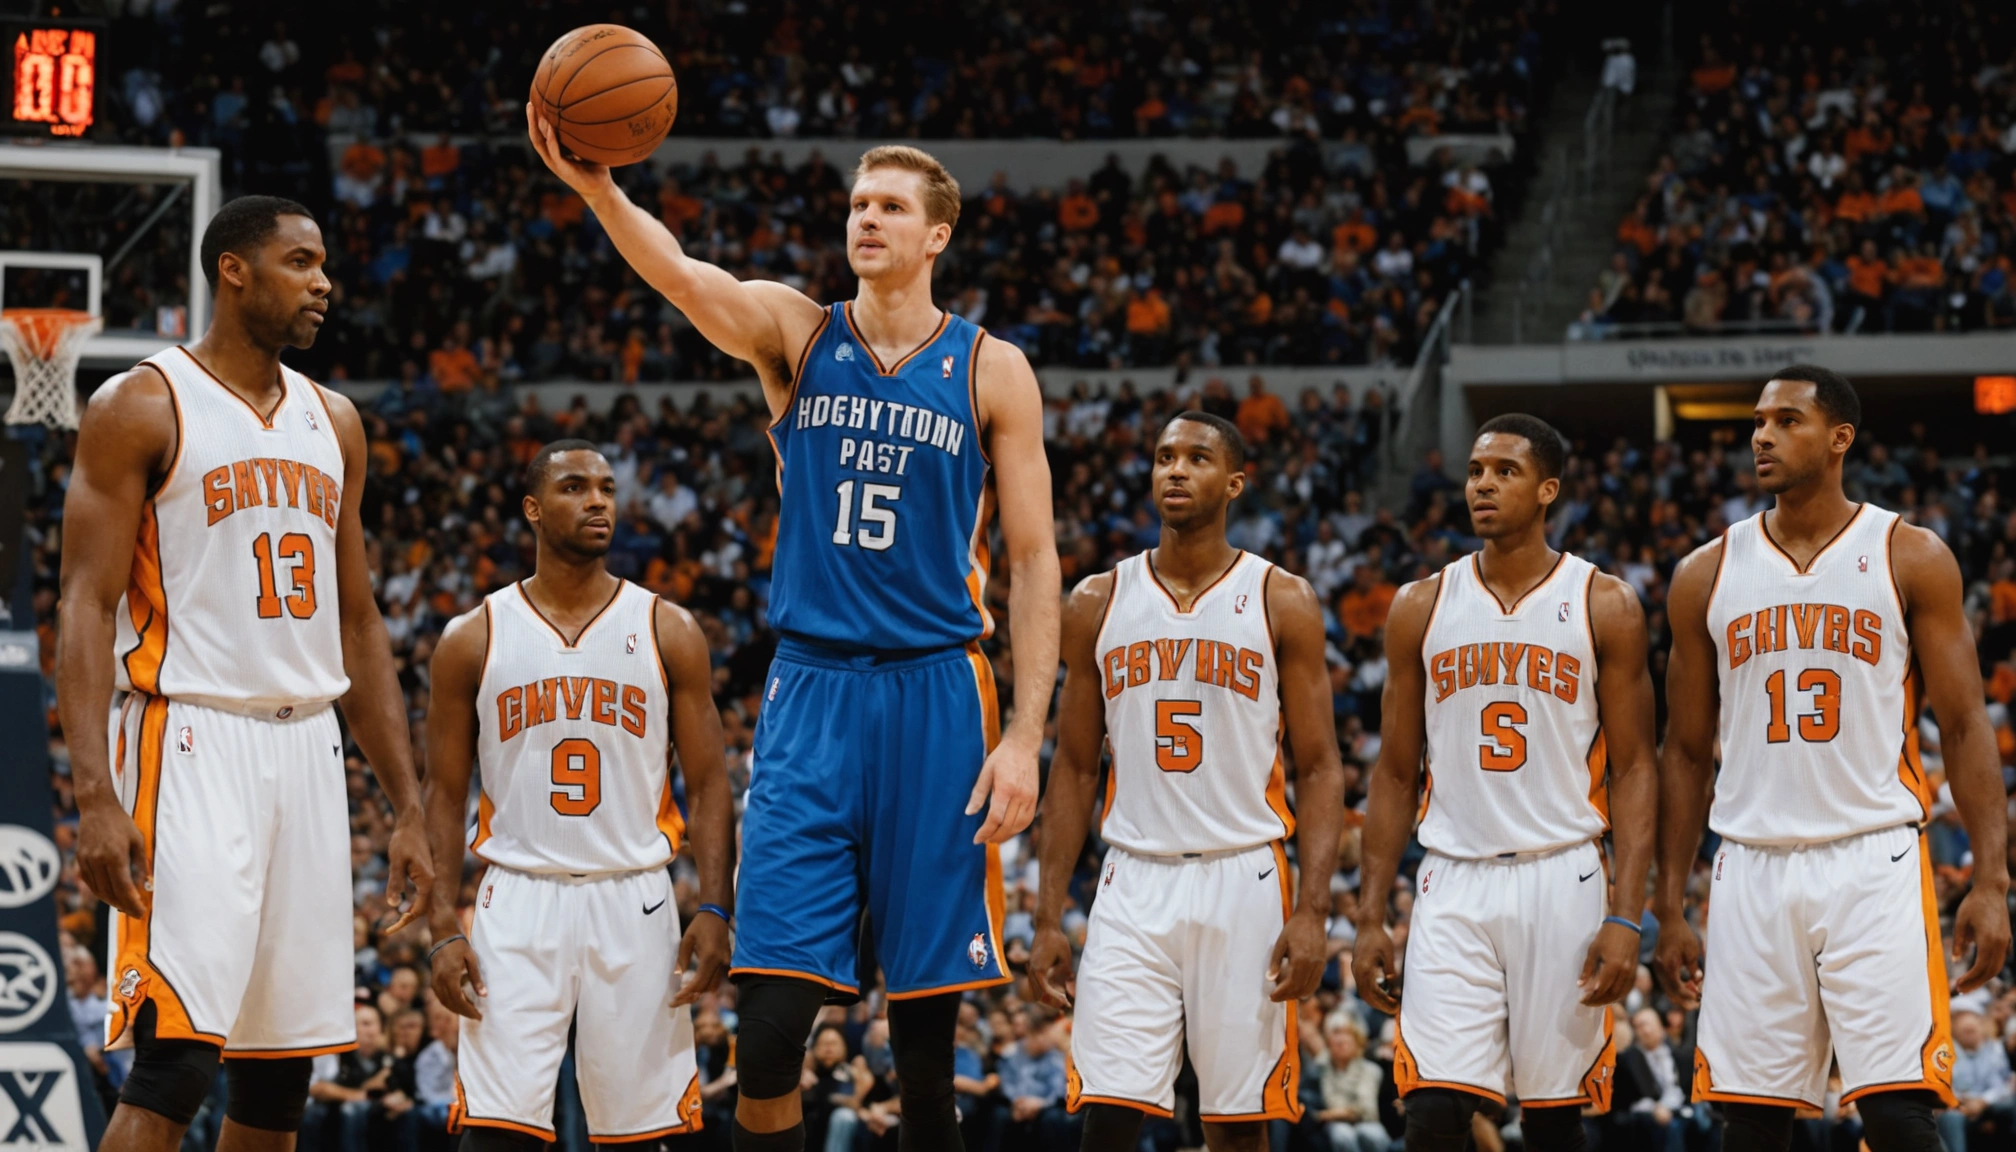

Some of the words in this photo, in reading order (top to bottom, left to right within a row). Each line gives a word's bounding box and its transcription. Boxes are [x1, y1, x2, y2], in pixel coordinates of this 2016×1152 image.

[832, 480, 901, 550] 15
[253, 532, 317, 619] 13
[1155, 699, 1203, 773] 5
[1765, 668, 1841, 744] 13
[550, 738, 601, 816] 9
